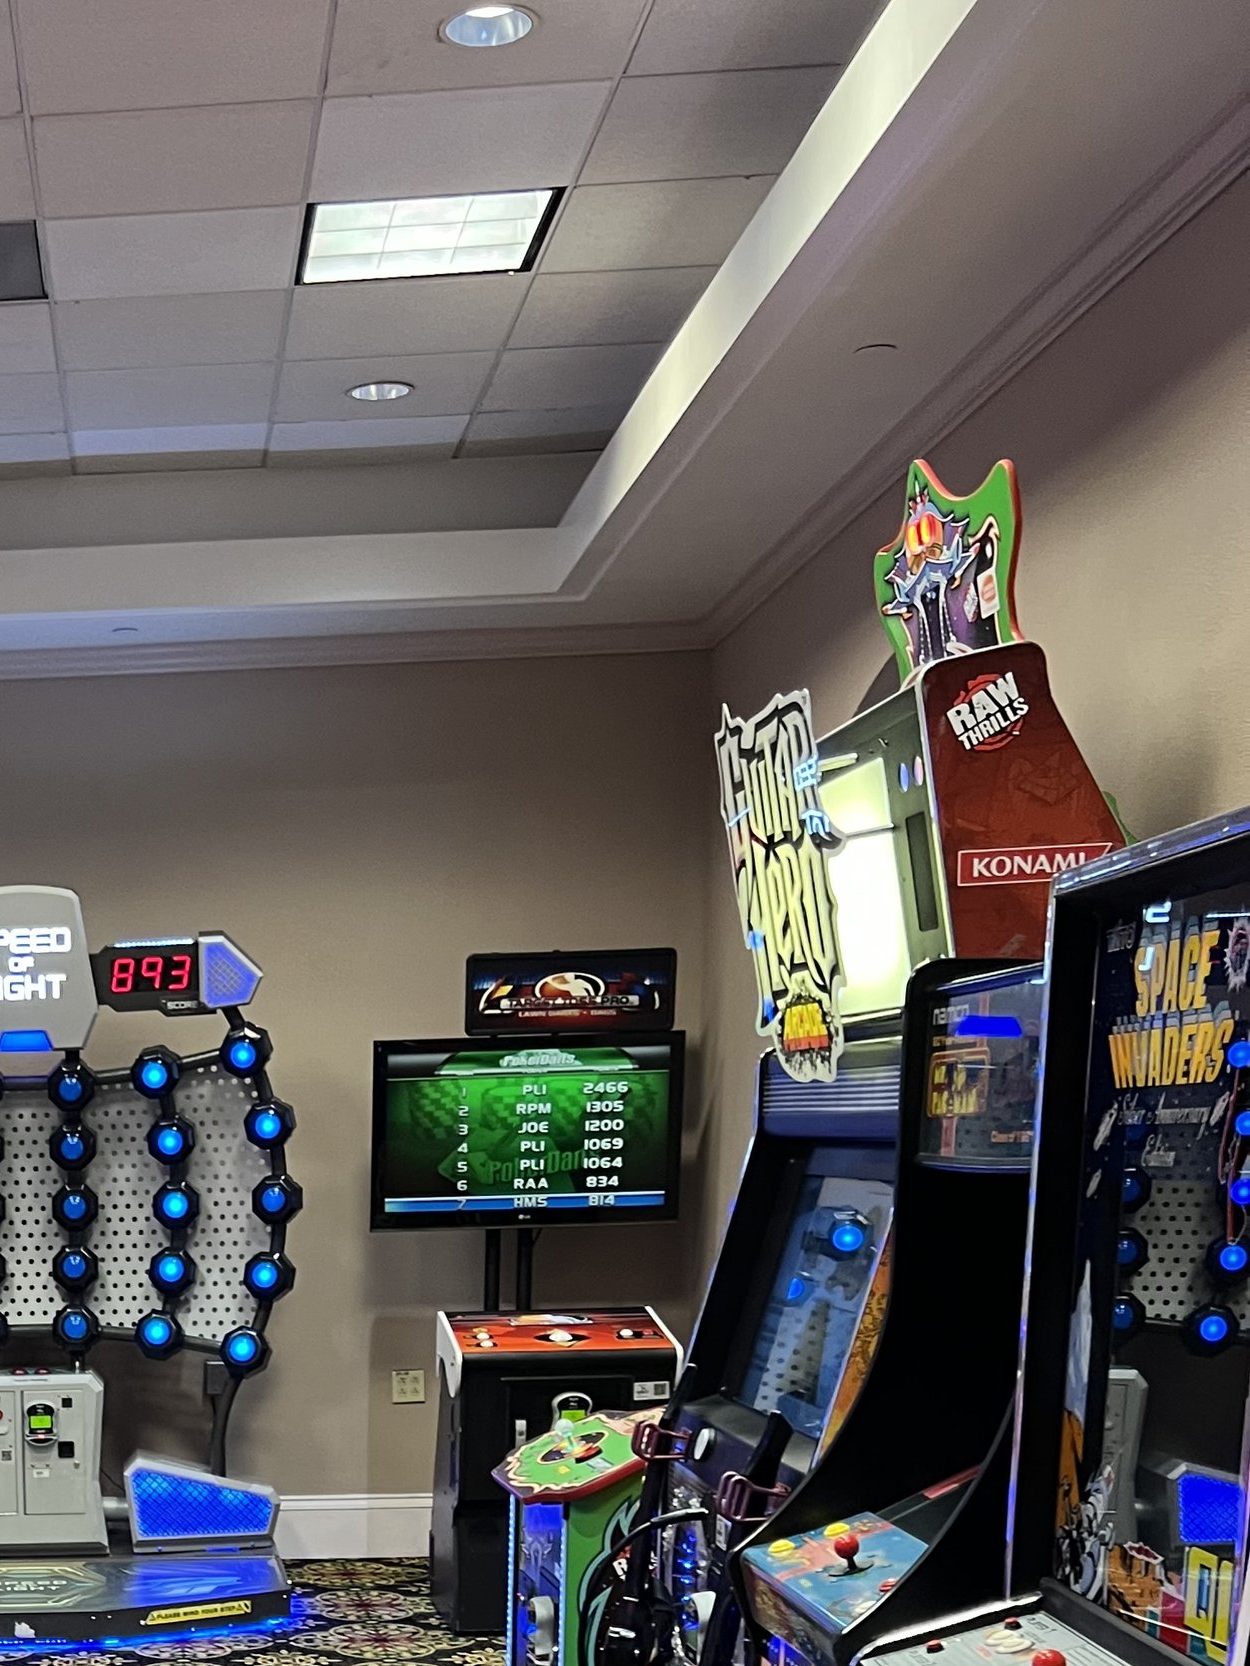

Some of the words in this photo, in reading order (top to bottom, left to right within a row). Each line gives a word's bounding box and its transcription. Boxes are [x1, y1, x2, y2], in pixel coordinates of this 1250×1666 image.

[947, 672, 1019, 735] RAW
[958, 697, 1029, 750] THRILLS
[972, 852, 1086, 878] KONAMI
[8, 956, 34, 972] OF
[1134, 918, 1220, 1017] SPACE
[111, 955, 191, 992] 893
[167, 1001, 198, 1010] SCORE
[600, 995, 630, 1006] PRO
[1108, 1016, 1235, 1088] INVADERS
[522, 1084, 547, 1095] PLI
[583, 1081, 628, 1094] 2466
[458, 1106, 469, 1117] 2
[516, 1103, 552, 1115] RPM
[586, 1100, 624, 1113] 1305
[458, 1124, 469, 1136] 3
[518, 1122, 549, 1134] JOE
[585, 1119, 624, 1131] 1200
[457, 1142, 469, 1154] 4
[520, 1140, 545, 1152] PLI
[584, 1137, 624, 1150] 1069
[457, 1161, 468, 1173] 5
[520, 1159, 545, 1171] PLI
[583, 1156, 623, 1169] 1064
[457, 1179, 468, 1191] 6
[513, 1177, 549, 1189] RAA
[586, 1175, 619, 1187] 834
[457, 1198, 467, 1210] 7
[588, 1194, 615, 1206] 814
